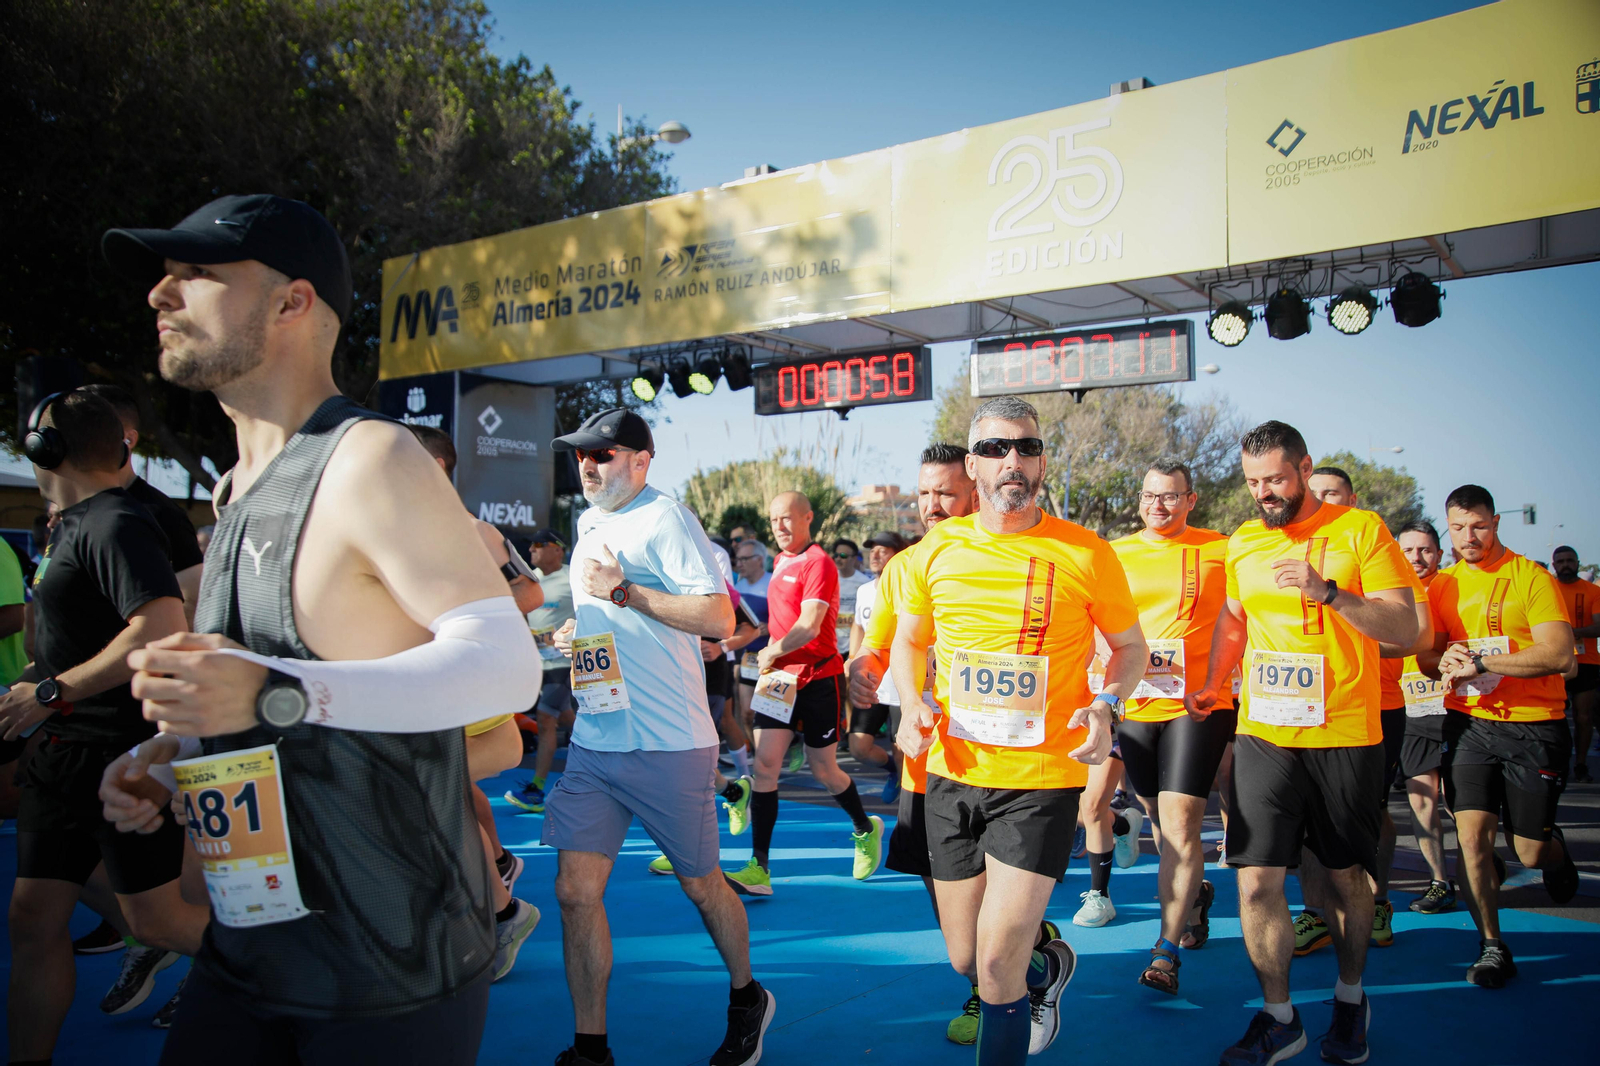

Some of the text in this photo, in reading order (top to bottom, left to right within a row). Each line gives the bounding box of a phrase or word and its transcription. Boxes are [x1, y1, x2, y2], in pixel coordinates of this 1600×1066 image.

[1401, 79, 1545, 155] NEXAL
[1412, 139, 1439, 153] 2020
[1265, 146, 1374, 177] COOPERACIÓN
[988, 117, 1124, 242] 25
[1265, 173, 1301, 190] 2005
[987, 229, 1124, 278] EDICIÓN
[494, 253, 641, 297] Medio Maratón
[654, 258, 841, 303] RAMÓN RUIZ ANDÚJAR
[461, 281, 480, 303] 25
[492, 279, 641, 327] Almería 2024
[476, 436, 538, 452] COOPERACIÓN
[478, 500, 537, 527] NEXAL
[766, 676, 790, 695] 727
[959, 666, 1037, 698] 1959
[1257, 664, 1314, 688] 1970
[1406, 679, 1444, 695] 197
[1263, 686, 1299, 695] ALEJANDRO
[193, 772, 217, 784] 2024
